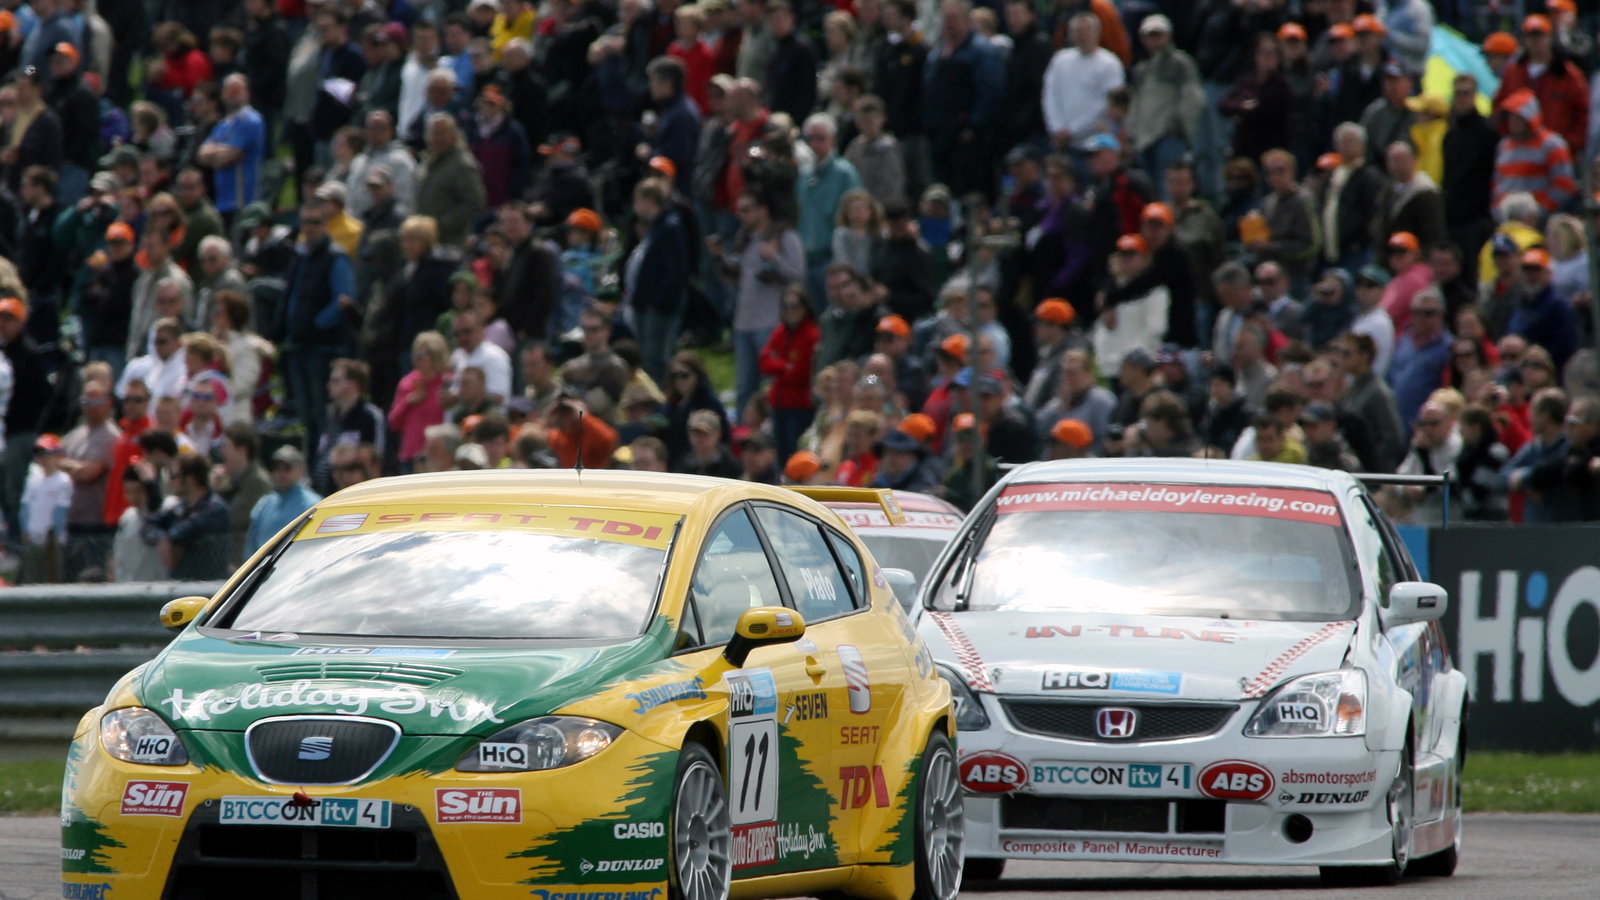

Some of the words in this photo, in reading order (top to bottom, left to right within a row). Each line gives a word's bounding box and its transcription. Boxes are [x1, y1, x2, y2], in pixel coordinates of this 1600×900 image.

[996, 487, 1336, 515] www.michaeldoyleracing.com
[375, 512, 547, 526] SEAT
[569, 517, 662, 540] TDI
[800, 567, 836, 601] Plato
[1043, 671, 1107, 688] HiQ
[161, 679, 371, 721] Holiday
[380, 685, 505, 723] Inn
[730, 680, 754, 713] HiQ
[795, 692, 828, 721] SEVEN
[1281, 705, 1319, 721] HiQ
[840, 725, 881, 745] SEAT
[136, 738, 171, 756] HiQ
[481, 745, 527, 765] HiQ
[740, 731, 768, 814] 11
[966, 764, 1019, 784] ABS
[1211, 772, 1266, 792] ABS
[1281, 769, 1377, 788] absmotorsport.net
[124, 783, 184, 808] Sun
[839, 765, 890, 810] TDI
[1297, 790, 1370, 804] DUNLOP
[439, 791, 518, 815] Sun
[613, 823, 664, 840] CASIO
[776, 822, 810, 860] Holiday
[746, 825, 776, 863] EXPRESS
[1003, 842, 1077, 855] Composite
[1082, 842, 1120, 855] Panel
[1126, 843, 1221, 858] Manufacturer
[596, 859, 664, 872] DUNLOP
